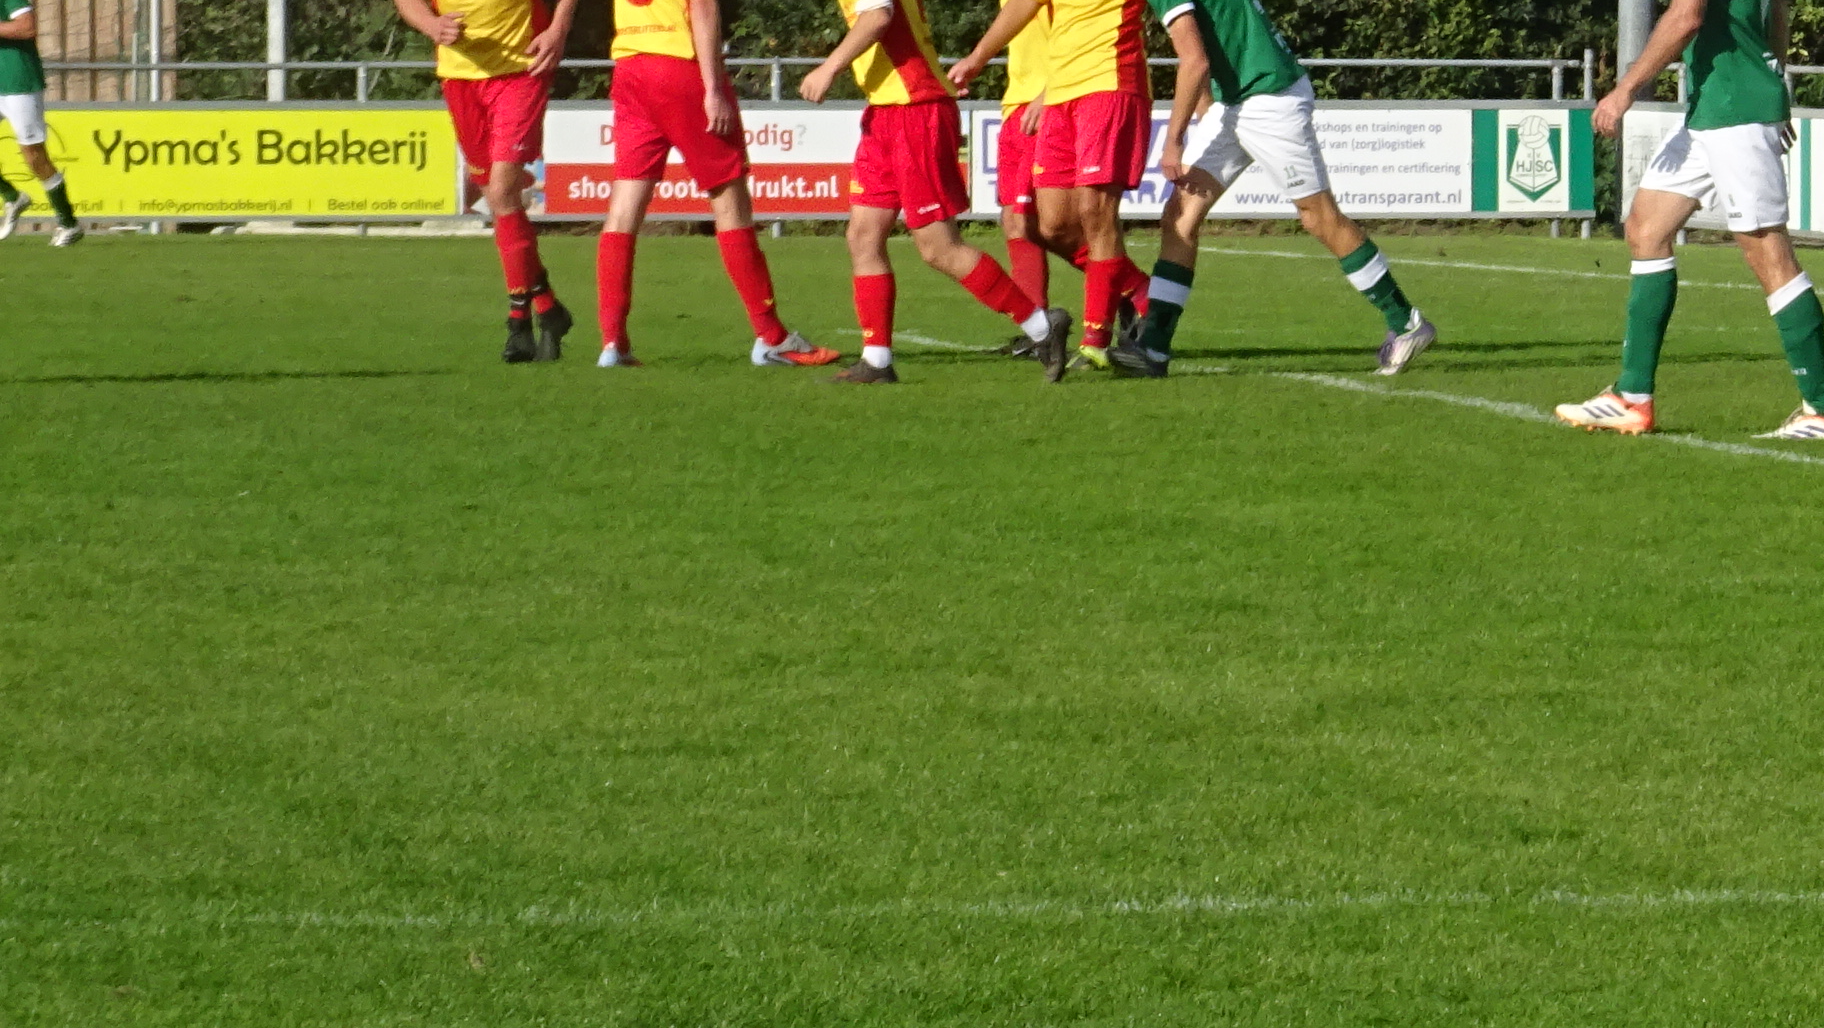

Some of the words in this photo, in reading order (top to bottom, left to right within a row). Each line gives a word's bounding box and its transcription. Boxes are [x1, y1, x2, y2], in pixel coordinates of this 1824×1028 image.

[1312, 122, 1353, 134] kshops
[1355, 123, 1369, 133] en
[1371, 122, 1426, 134] trainingen
[1428, 123, 1442, 134] op
[742, 124, 808, 151] odig?
[93, 129, 241, 172] Ypma's
[255, 128, 428, 171] Bakkerij
[1329, 140, 1349, 150] van
[1351, 138, 1426, 152] (zorg)logistiek
[1382, 164, 1396, 174] en
[1397, 162, 1461, 175] certificering
[1515, 159, 1554, 173] HJSC
[328, 197, 367, 212] Bestel
[371, 197, 397, 212] ook
[401, 197, 445, 212] online!
